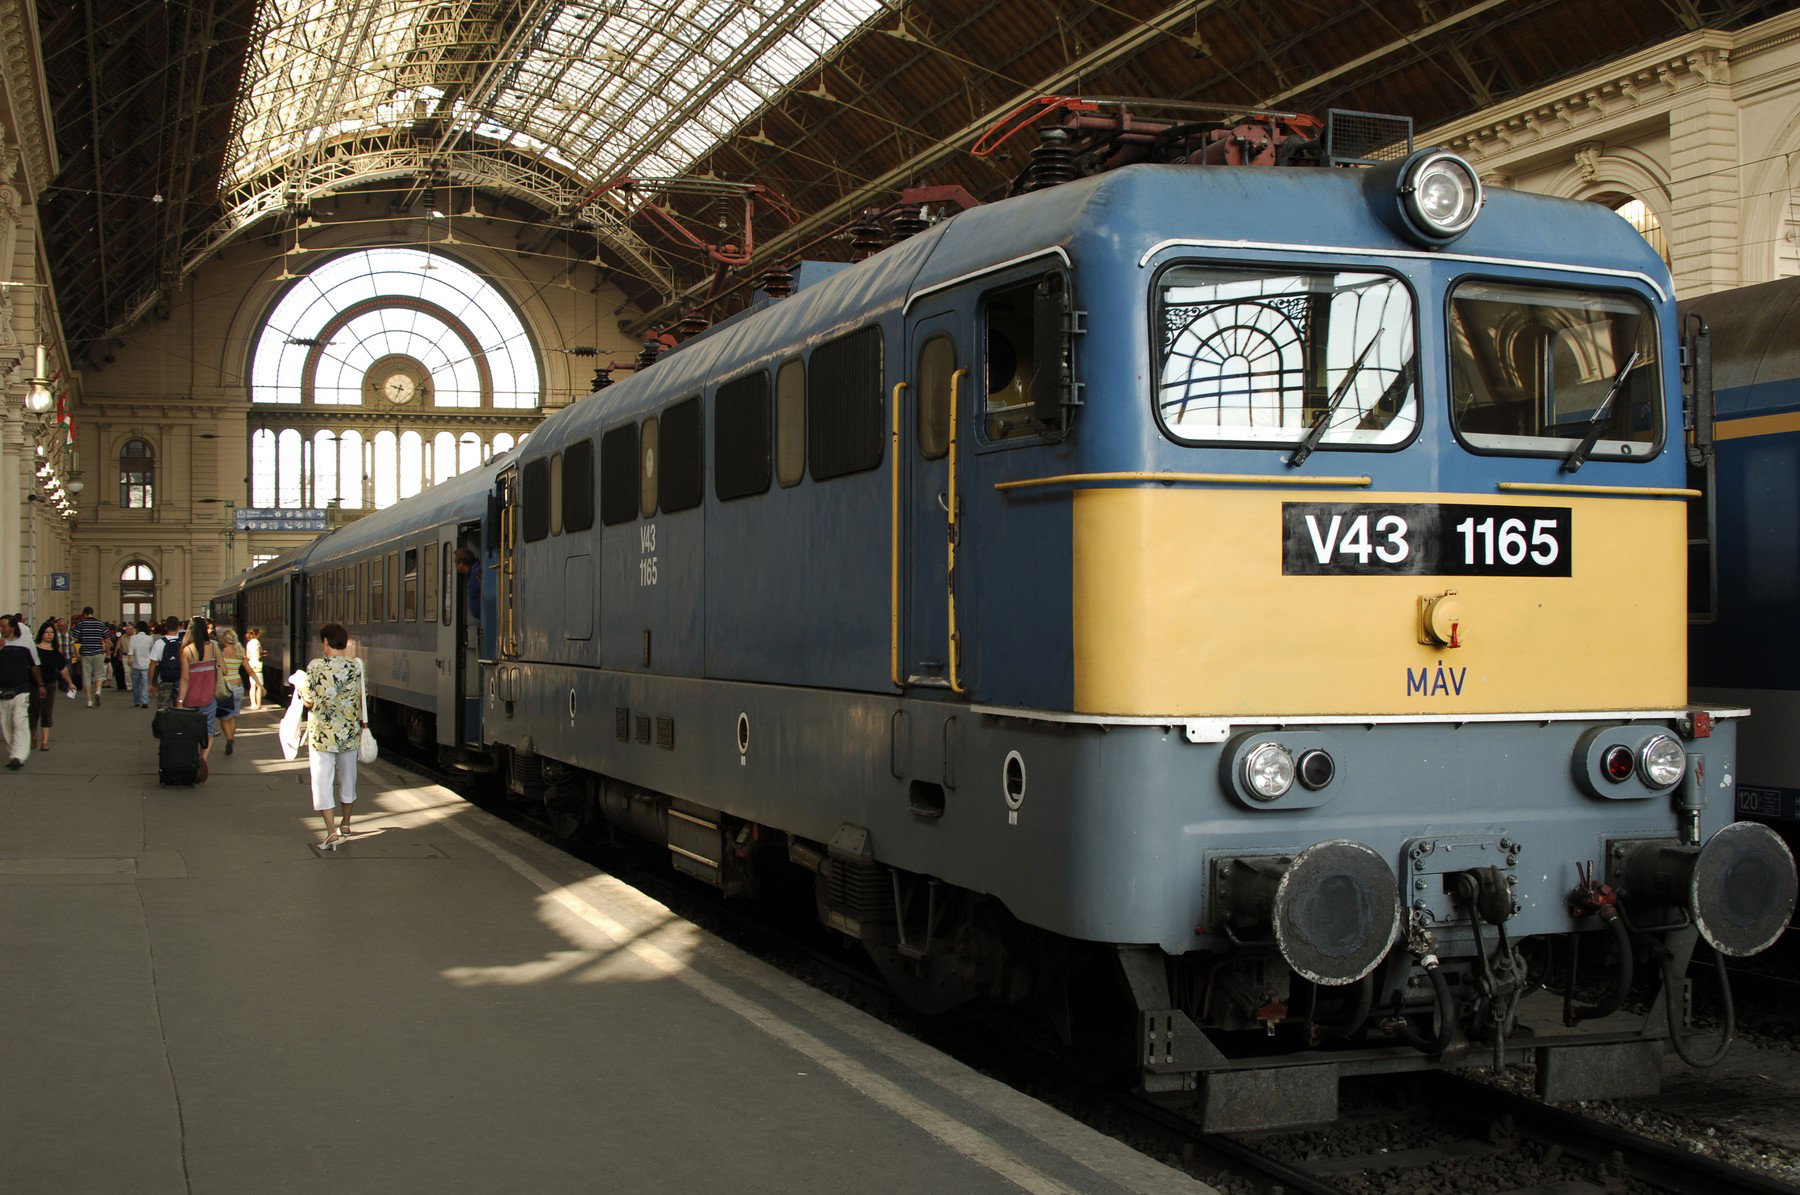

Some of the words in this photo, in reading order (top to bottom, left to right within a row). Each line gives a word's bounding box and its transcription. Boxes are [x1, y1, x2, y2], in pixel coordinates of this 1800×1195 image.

[640, 524, 656, 552] V43
[1305, 514, 1410, 564] V43
[1456, 517, 1559, 566] 1165
[639, 557, 658, 587] 1165
[1739, 791, 1758, 810] 120
